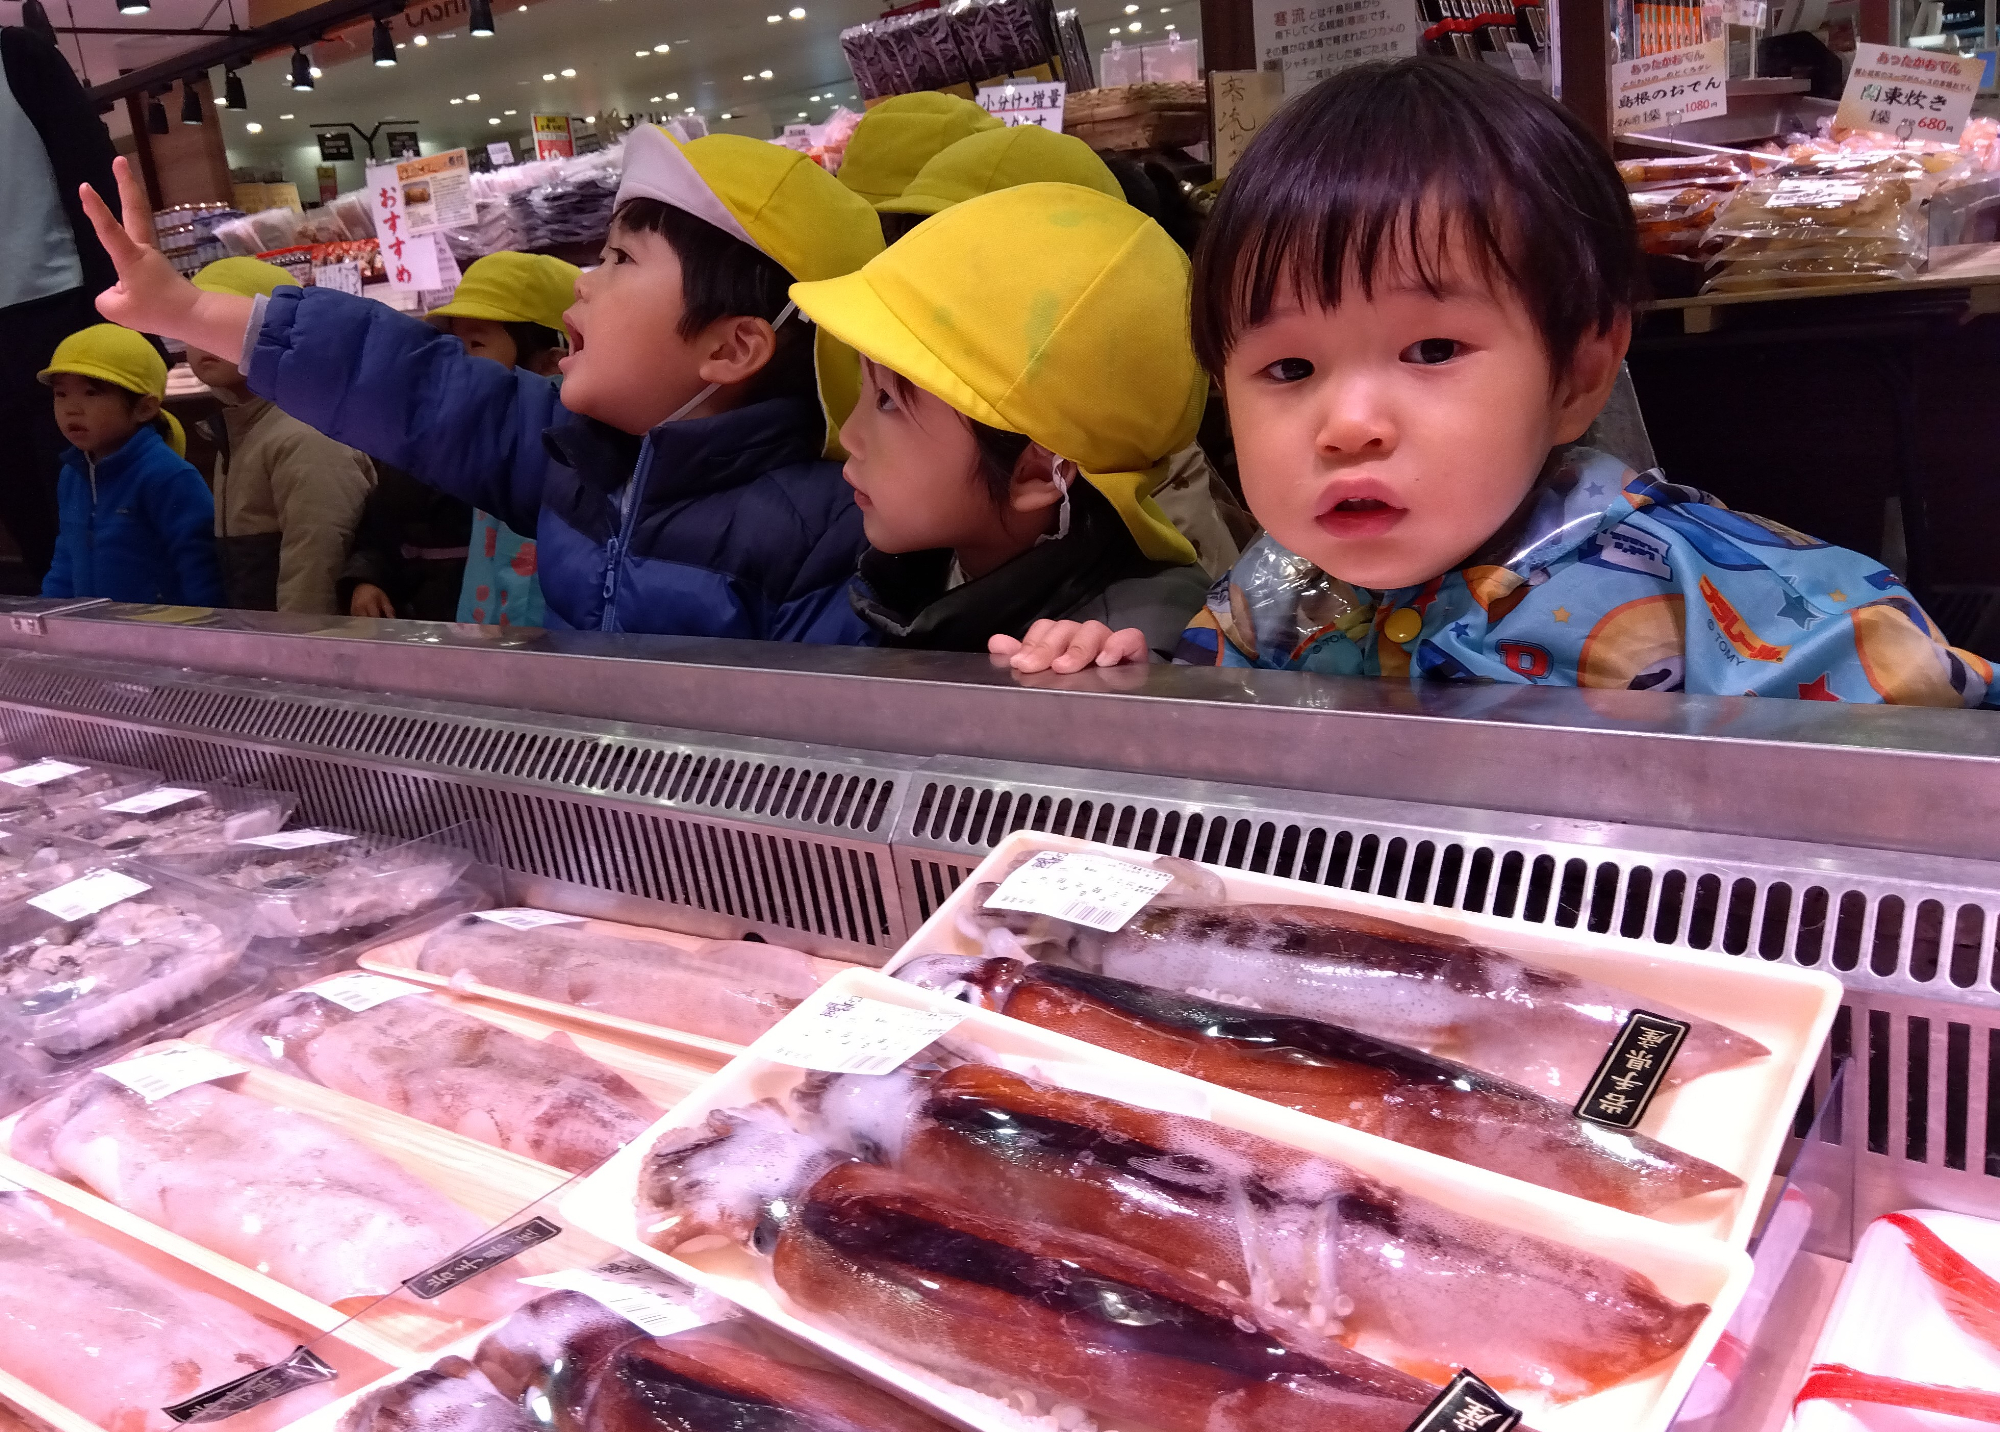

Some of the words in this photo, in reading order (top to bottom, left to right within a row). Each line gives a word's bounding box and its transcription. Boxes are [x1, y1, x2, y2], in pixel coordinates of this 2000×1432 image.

[1631, 50, 1705, 75] あったかおでん
[1876, 51, 1962, 76] あったかおでん
[1618, 76, 1721, 109] 島根のおでん
[1860, 83, 1947, 111] 関東炊き
[379, 186, 412, 283] おすすめ
[1715, 632, 1746, 667] TOMY
[1598, 1025, 1676, 1115] 岩手県産
[428, 1227, 542, 1291] 岩手県産
